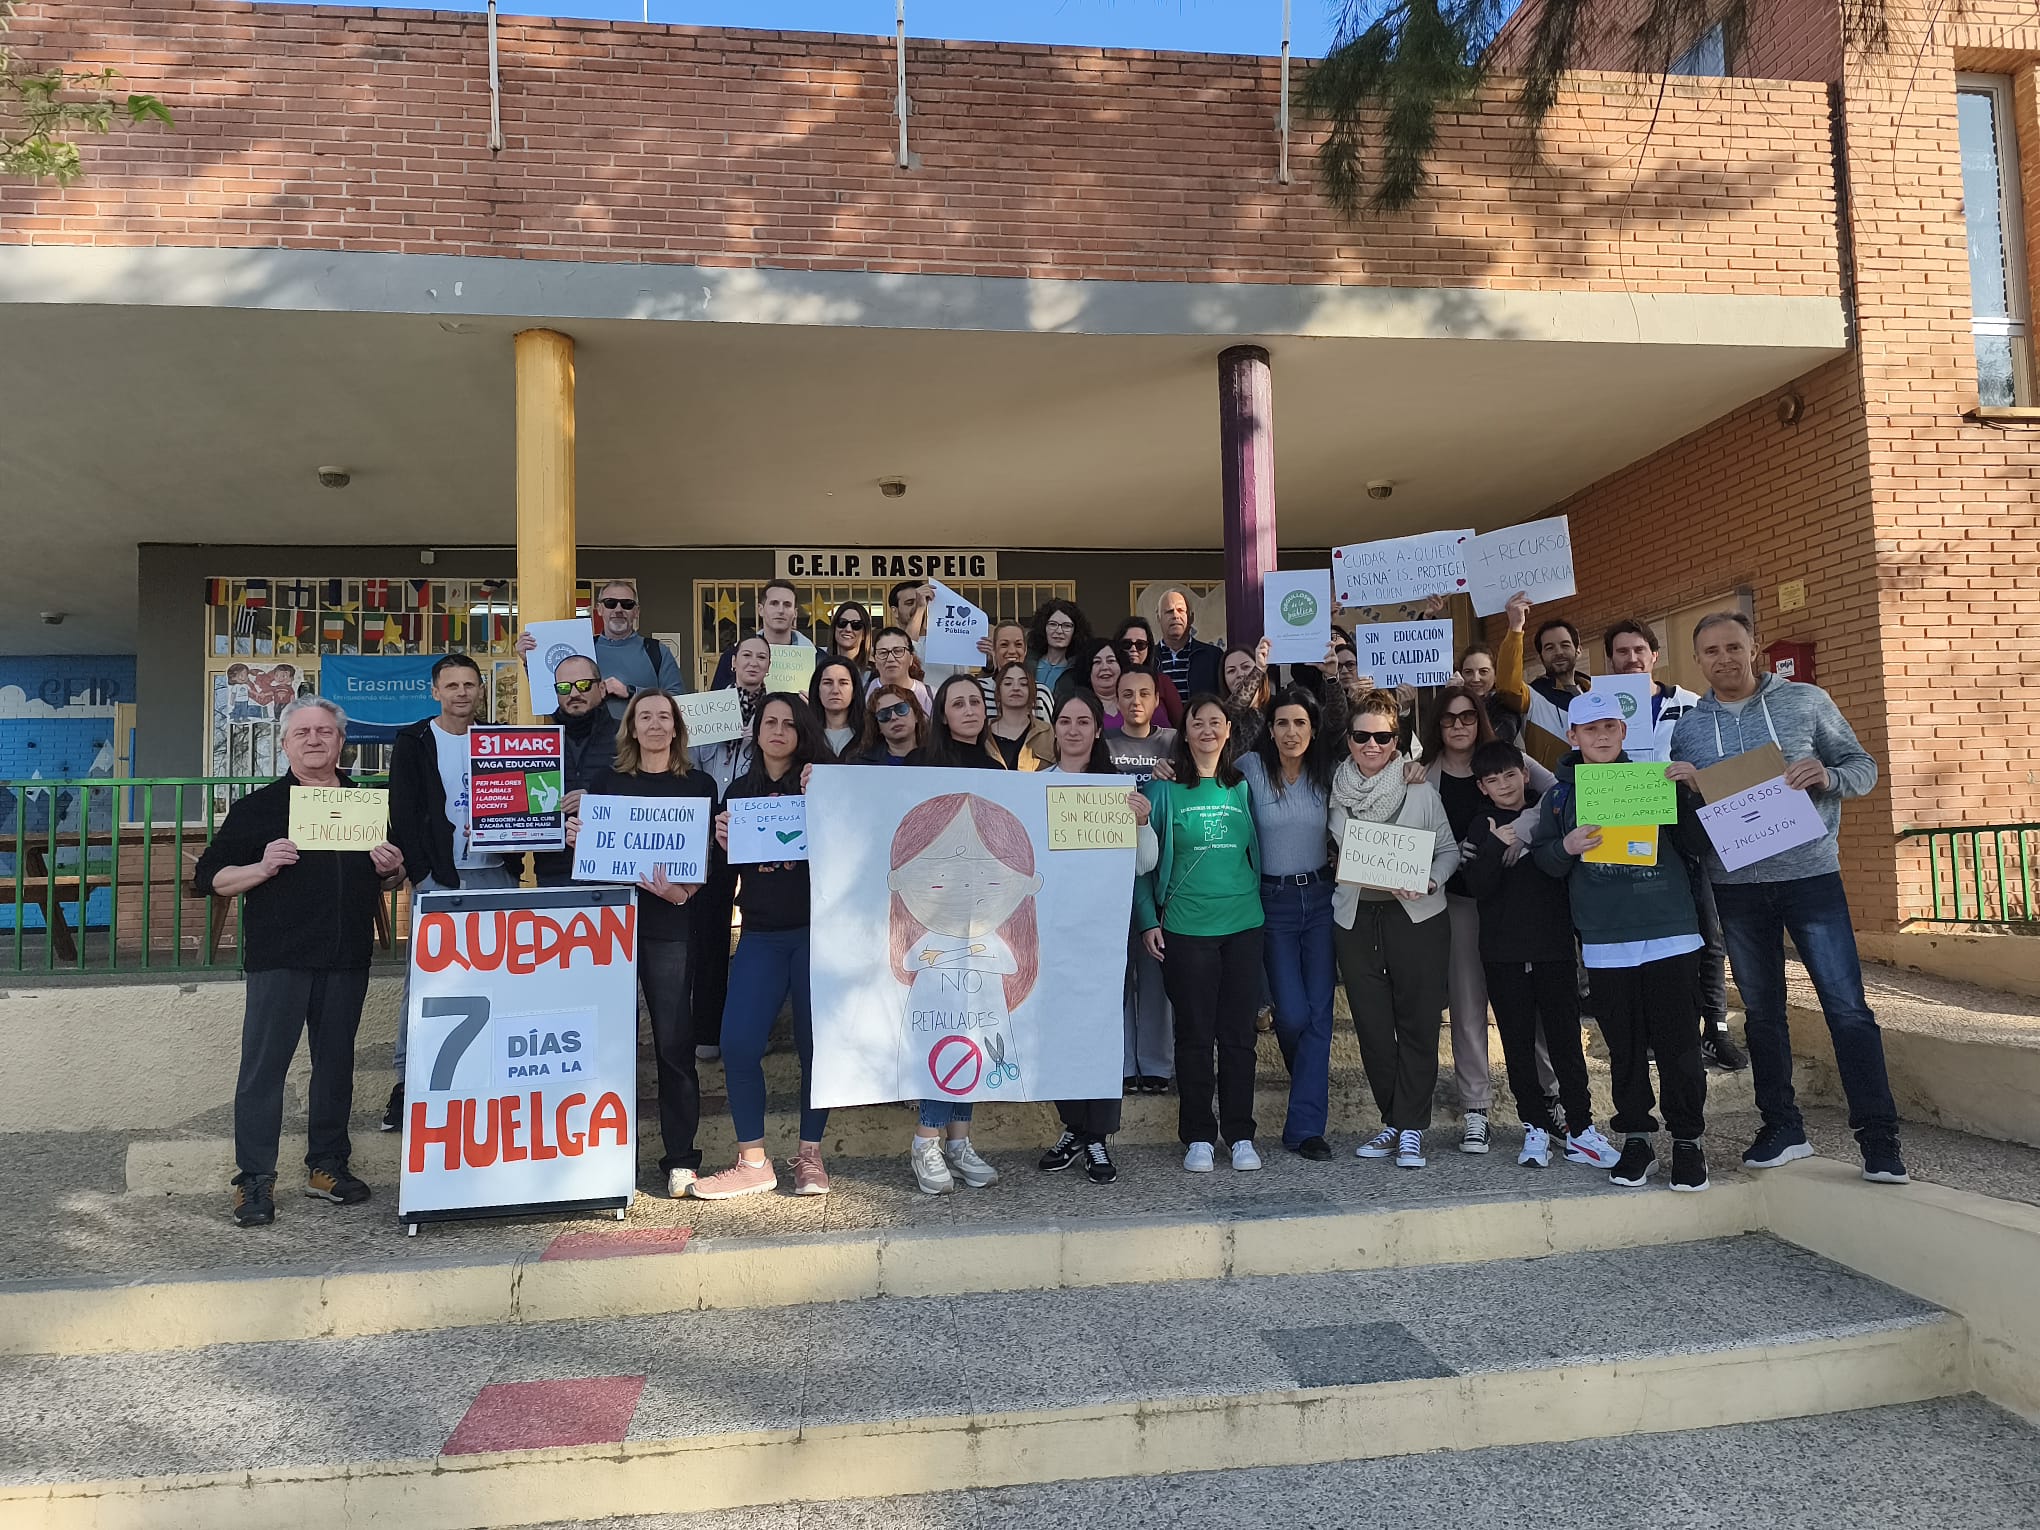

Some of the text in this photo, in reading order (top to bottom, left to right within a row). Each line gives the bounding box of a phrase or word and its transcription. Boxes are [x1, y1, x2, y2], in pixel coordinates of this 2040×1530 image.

[1343, 551, 1387, 569] CUIDAR
[1414, 544, 1456, 562] QUIEN
[1498, 534, 1569, 560] RECURSOS
[787, 554, 986, 577] C.E.I.P. RASPEIG
[1500, 564, 1573, 590] BUROCRACIA
[1375, 587, 1403, 599] QUIEN
[1412, 580, 1449, 595] APRENDE
[1365, 625, 1444, 644] SIN EDUCACIÓN
[1371, 648, 1440, 666] DE CALIDAD
[1386, 674, 1404, 686] HAY
[1416, 670, 1451, 685] FUTURO
[680, 699, 737, 717] RECURSOS
[686, 722, 744, 737] BUROCRACIA
[478, 735, 554, 754] 31 MARÇ
[477, 760, 556, 769] VAGA EDUCATIVA
[1580, 768, 1657, 781] CUIDAR A
[313, 788, 382, 805] RECURSOS
[1050, 792, 1067, 804] LA
[1586, 800, 1600, 808] ES
[1713, 784, 1782, 819] RECURSOS
[592, 805, 695, 823] SIN EDUCACIÓN
[734, 801, 781, 812] L'ESCOLA
[734, 814, 801, 825] ES DEFENSA
[1060, 810, 1135, 825] SIN RECURSOS
[1597, 812, 1625, 821] QUIEN
[306, 820, 385, 842] INCLUSIÓN
[1054, 828, 1124, 844] ES FICCIÓN
[1349, 824, 1418, 852] RECORTES
[1734, 817, 1796, 850] INCLUSIÓN
[596, 831, 686, 851] DE CALIDAD
[579, 859, 597, 874] NO
[611, 860, 637, 876] HAY
[415, 904, 636, 975] QUEDAN
[941, 969, 983, 994] NO
[911, 1009, 1000, 1032] RETALLADES
[421, 996, 491, 1092] 7
[507, 1028, 582, 1058] DÍAS
[508, 1060, 582, 1078] PARA LA
[408, 1091, 628, 1173] HUELGA
